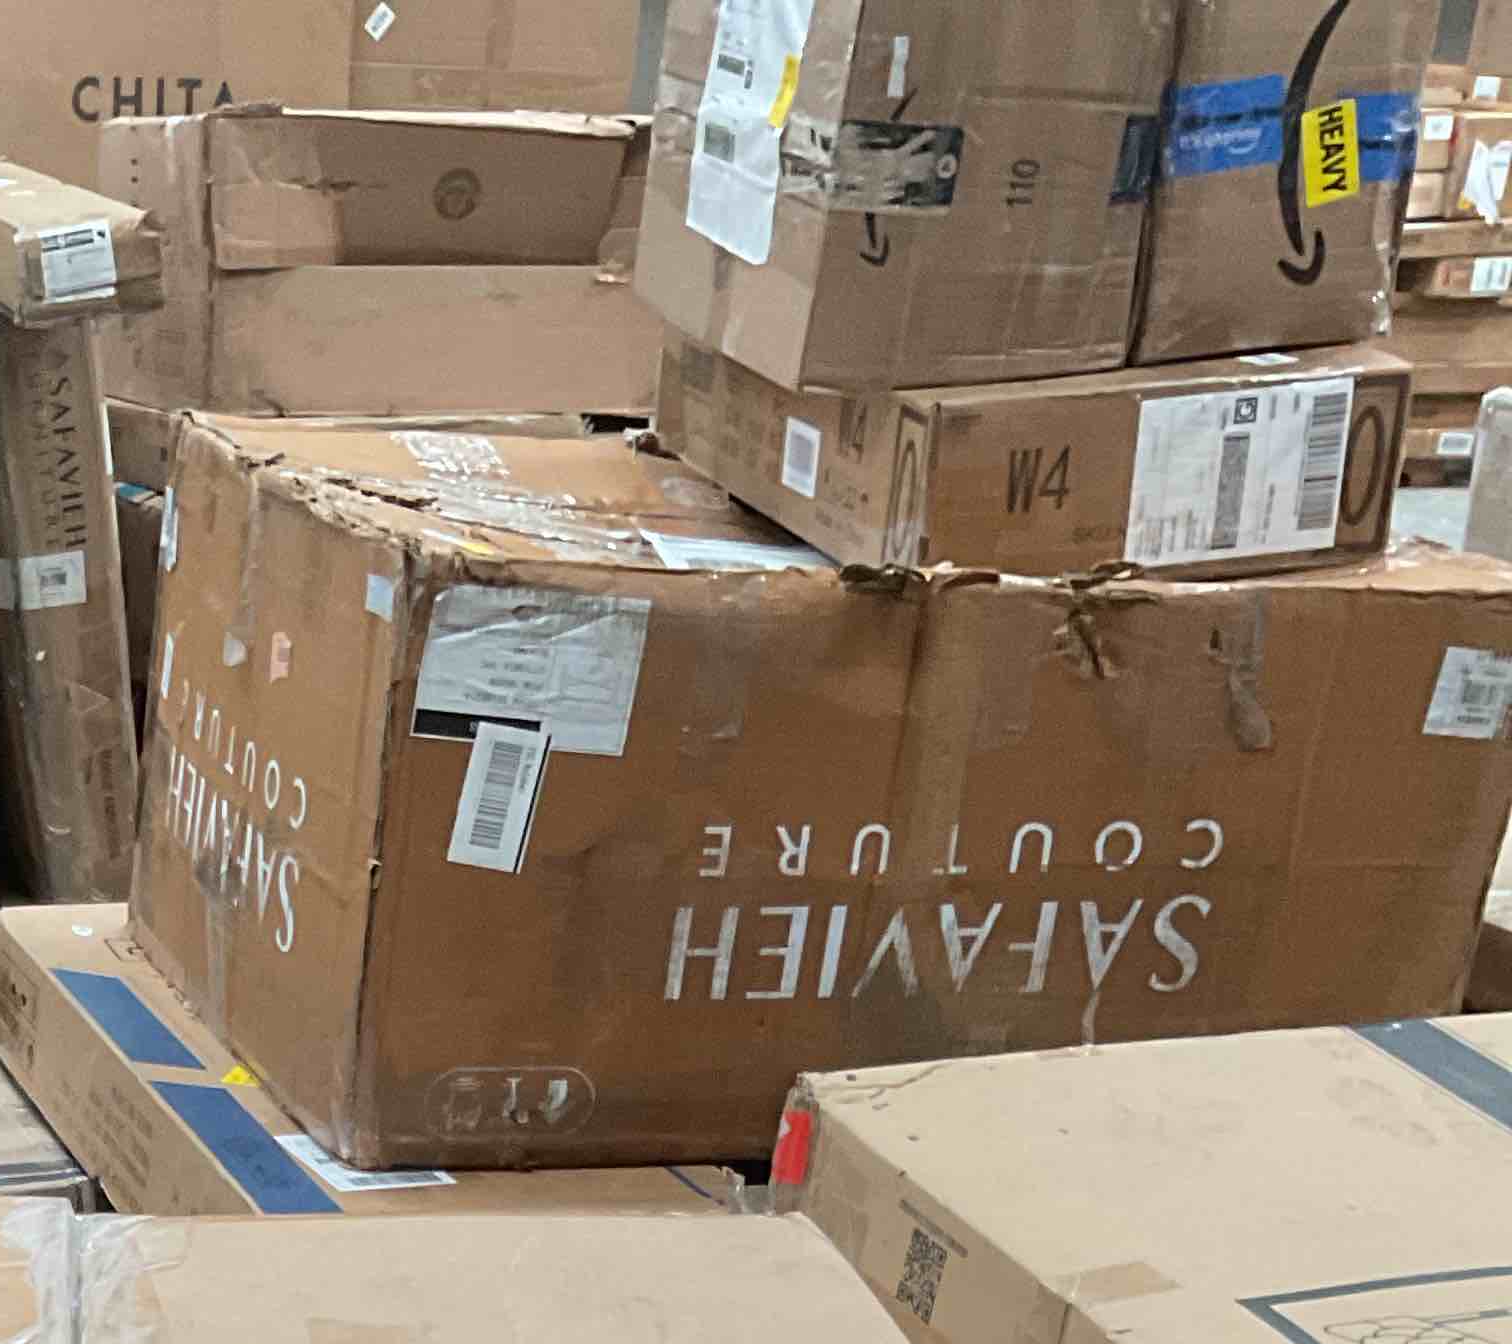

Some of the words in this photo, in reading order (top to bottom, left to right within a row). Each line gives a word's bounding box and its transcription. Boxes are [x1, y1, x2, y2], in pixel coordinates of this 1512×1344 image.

[71, 75, 233, 122] CHITA
[1317, 105, 1348, 193] HEAVY
[48, 375, 88, 550] SAFAVIEH
[1006, 445, 1071, 514] W4
[697, 818, 1225, 879] COUTURE
[664, 893, 1212, 1001] SAFAVIEH
